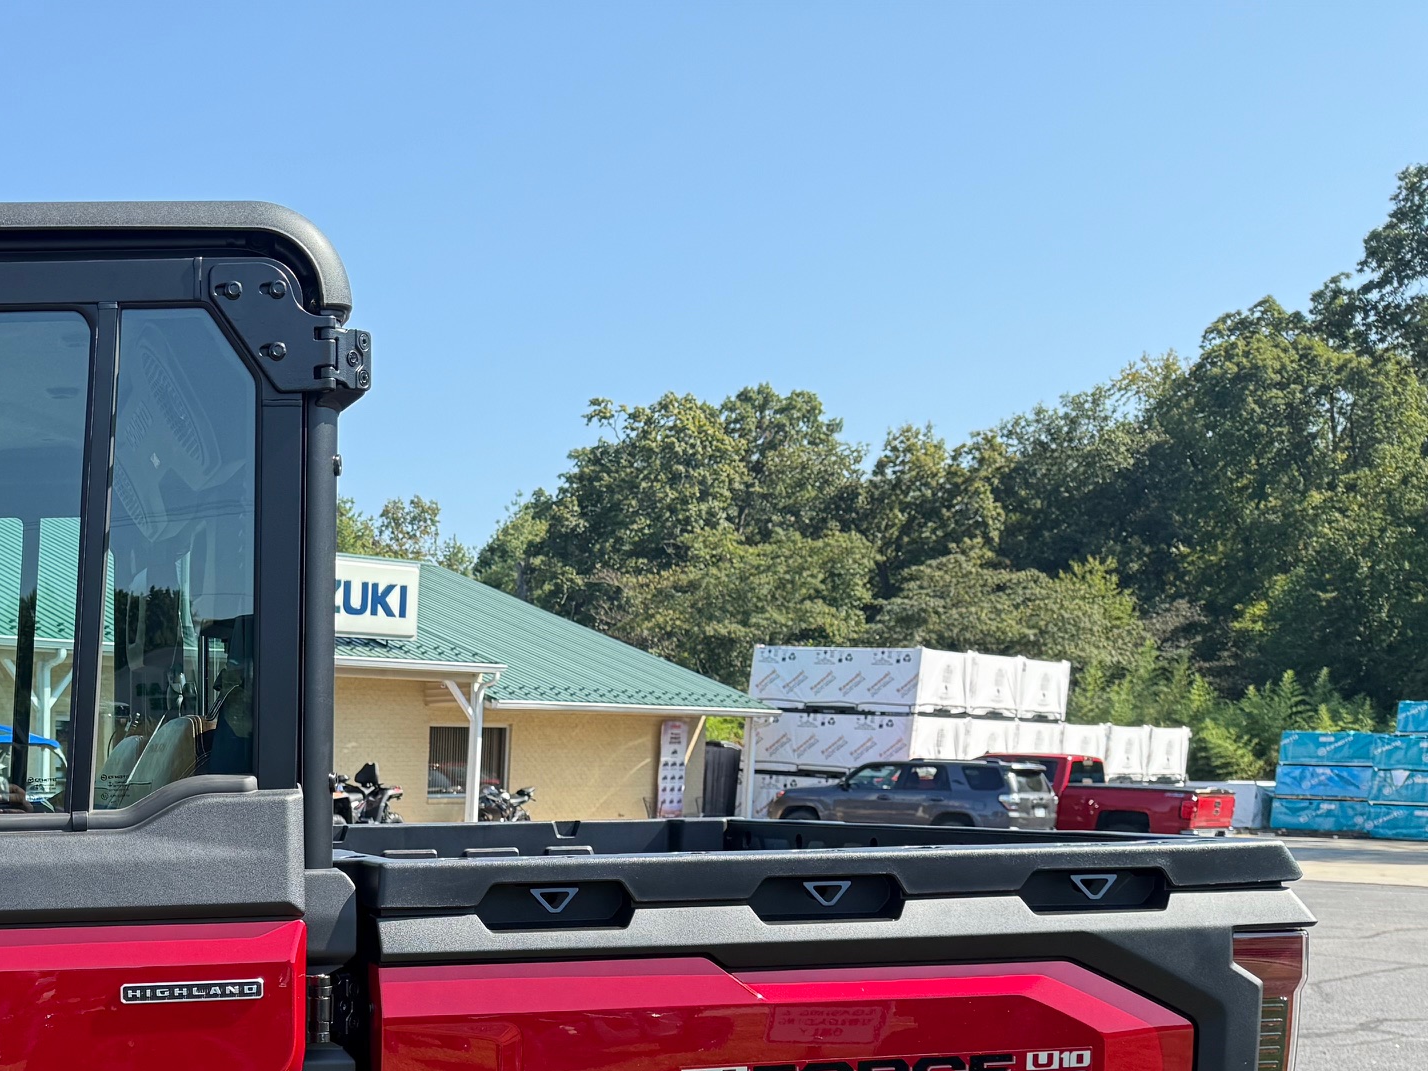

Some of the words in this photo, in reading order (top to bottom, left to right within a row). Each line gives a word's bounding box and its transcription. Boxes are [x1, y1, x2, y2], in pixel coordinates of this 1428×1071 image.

[335, 578, 408, 619] UKI
[127, 984, 258, 998] HIGHLAND
[1026, 1050, 1091, 1070] U10
